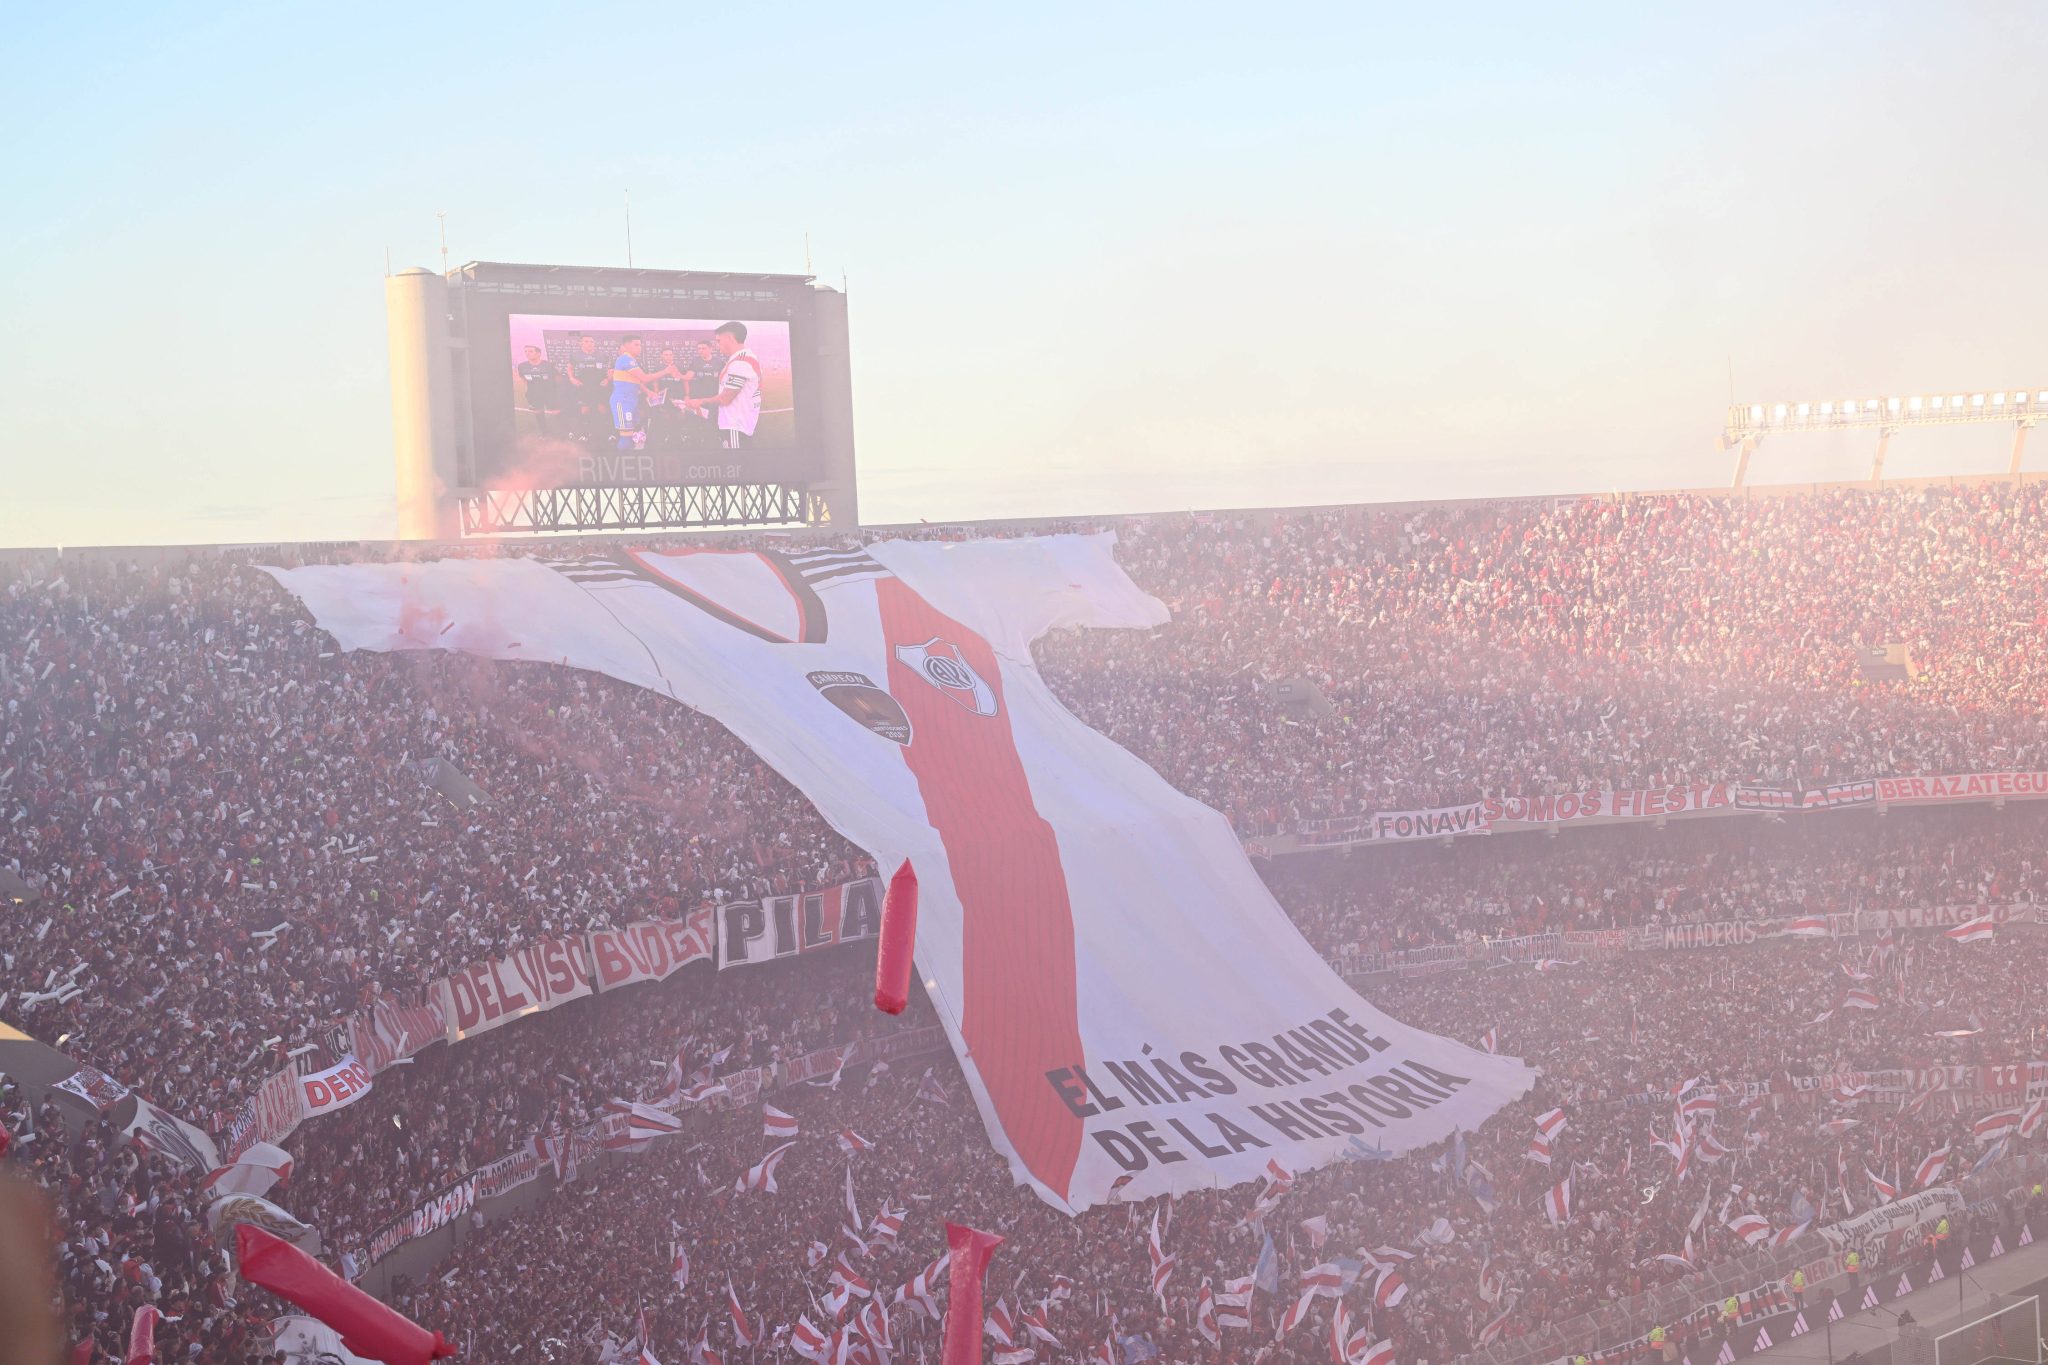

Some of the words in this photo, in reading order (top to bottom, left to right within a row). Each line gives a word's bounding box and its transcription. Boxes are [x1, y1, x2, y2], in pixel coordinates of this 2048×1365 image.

[1378, 806, 1480, 837] FONAVI
[1484, 789, 1601, 822] SOMOS
[1611, 782, 1730, 817] FIESTA
[1664, 919, 1757, 951] MATADEROS
[450, 961, 528, 1031] DEL
[512, 938, 590, 1001] VISO
[1044, 1063, 1125, 1120] EL
[1103, 1042, 1239, 1105] MÁS
[1992, 1065, 2018, 1088] 77
[1090, 1120, 1188, 1172] DE
[1166, 1112, 1272, 1159] LA
[1250, 1059, 1472, 1142] HISTORIA
[1728, 1281, 1787, 1323] LATE
